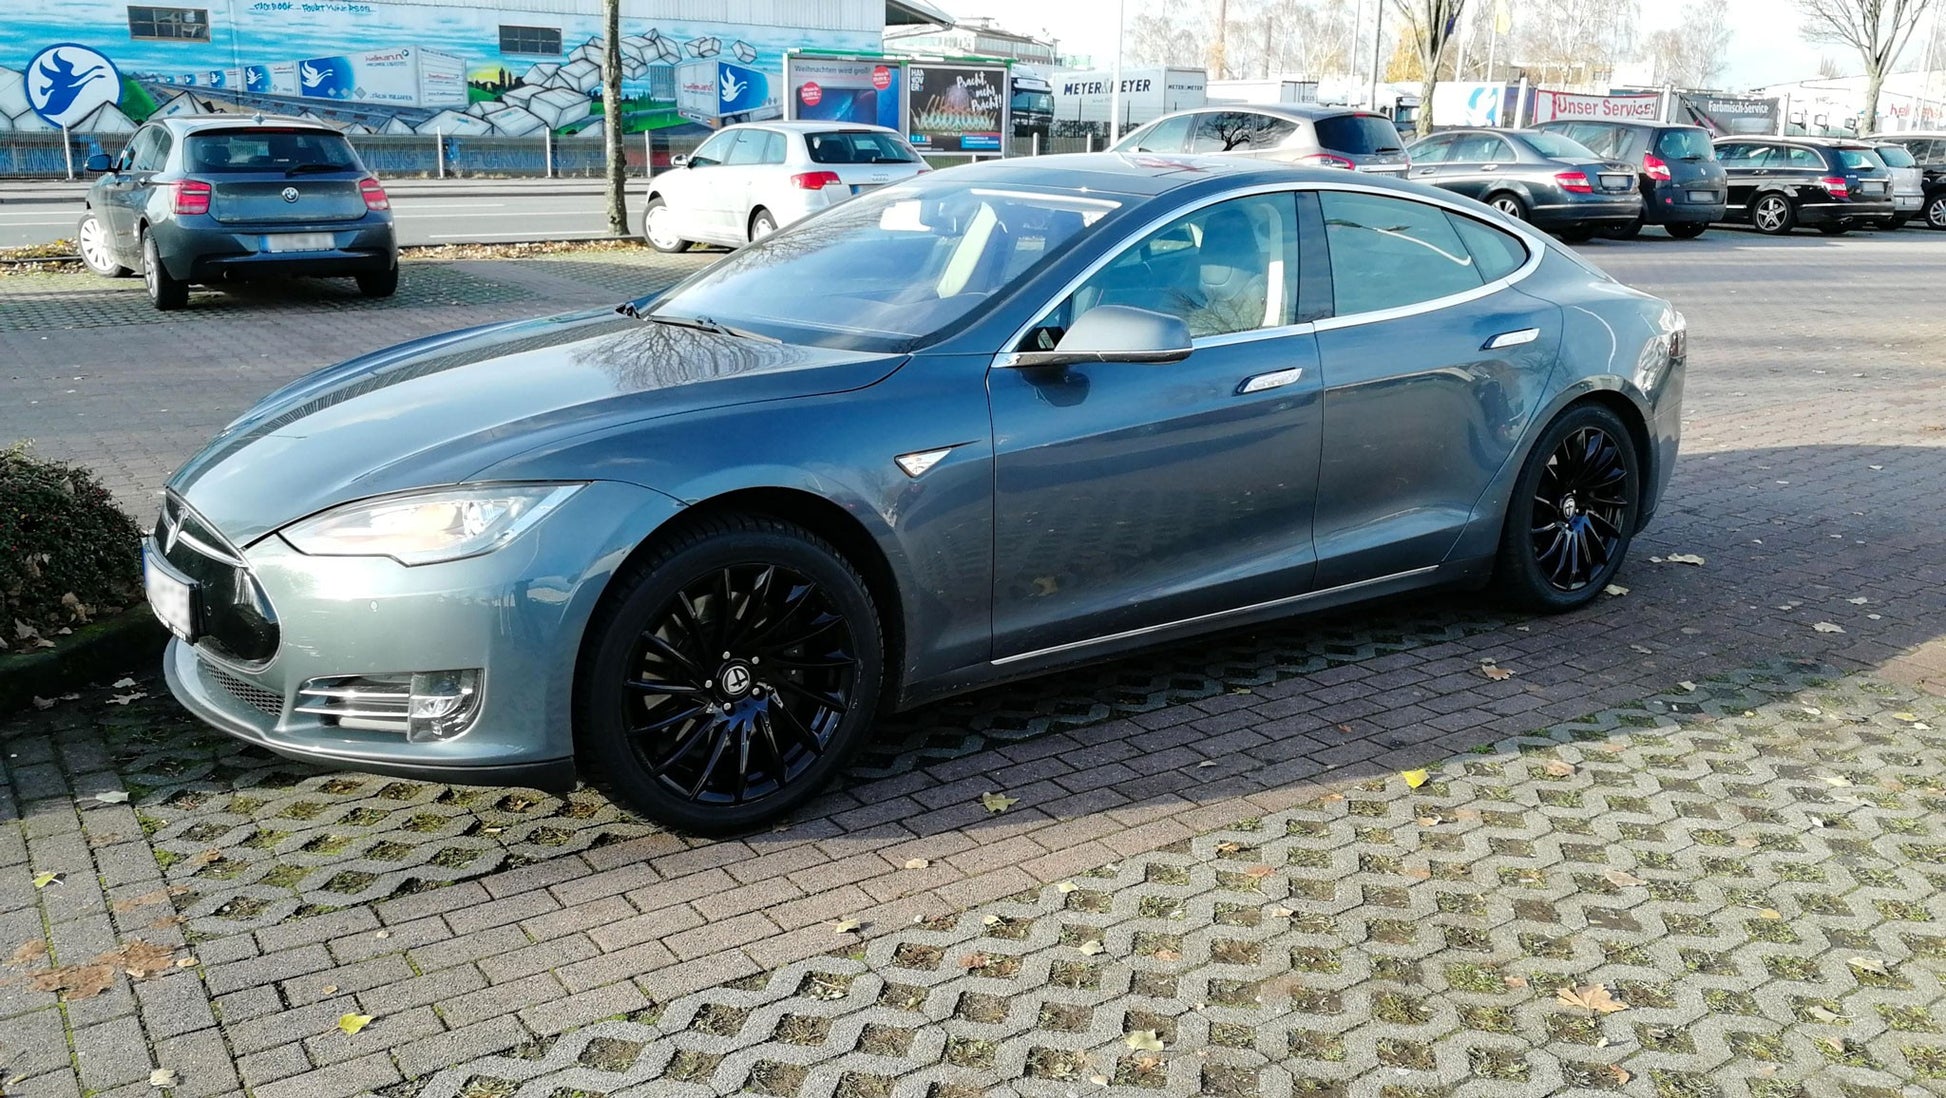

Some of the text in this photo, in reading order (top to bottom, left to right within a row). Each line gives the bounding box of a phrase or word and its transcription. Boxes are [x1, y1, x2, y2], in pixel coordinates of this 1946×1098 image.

[795, 65, 836, 74] Weihnachten
[838, 66, 853, 75] wird
[1557, 97, 1655, 117] Unser Service:
[1708, 100, 1769, 114] Farbmisch-Service
